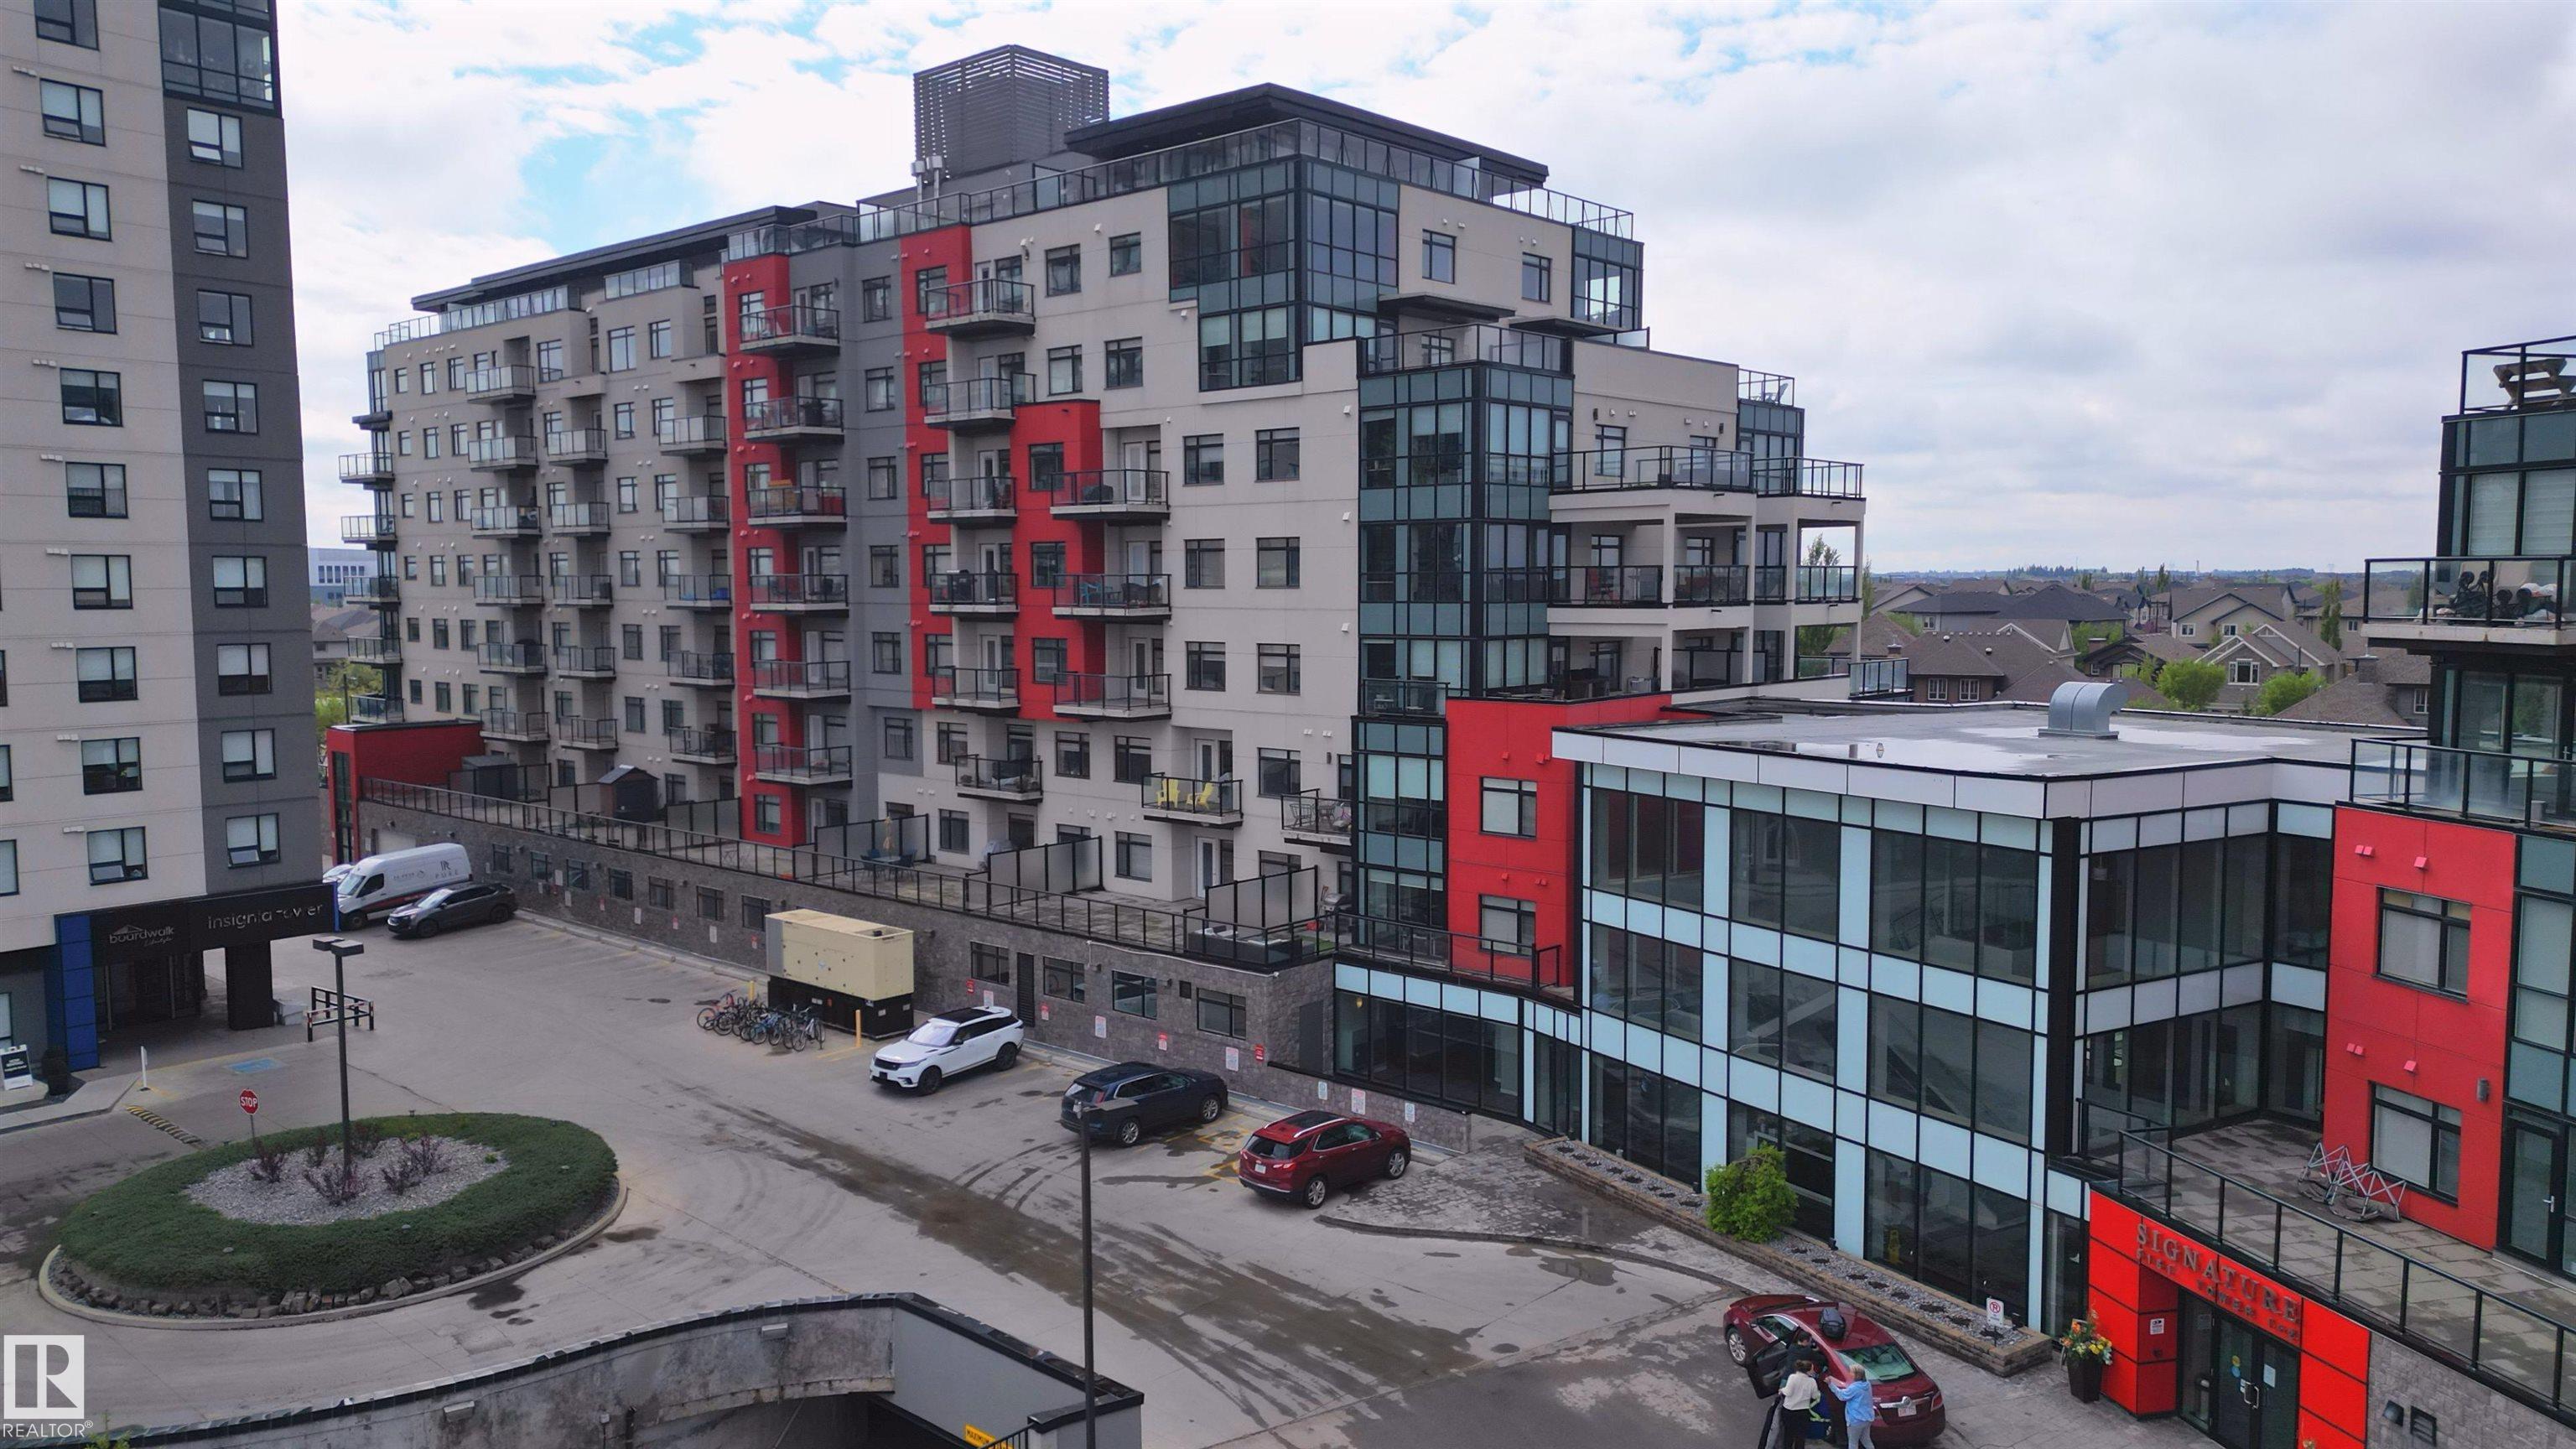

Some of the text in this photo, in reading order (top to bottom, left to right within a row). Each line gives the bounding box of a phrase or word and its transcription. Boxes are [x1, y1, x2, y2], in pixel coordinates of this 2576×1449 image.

[109, 926, 174, 944] boardwalk
[241, 1097, 257, 1108] STOP
[2137, 1223, 2298, 1322] SIGNATURE
